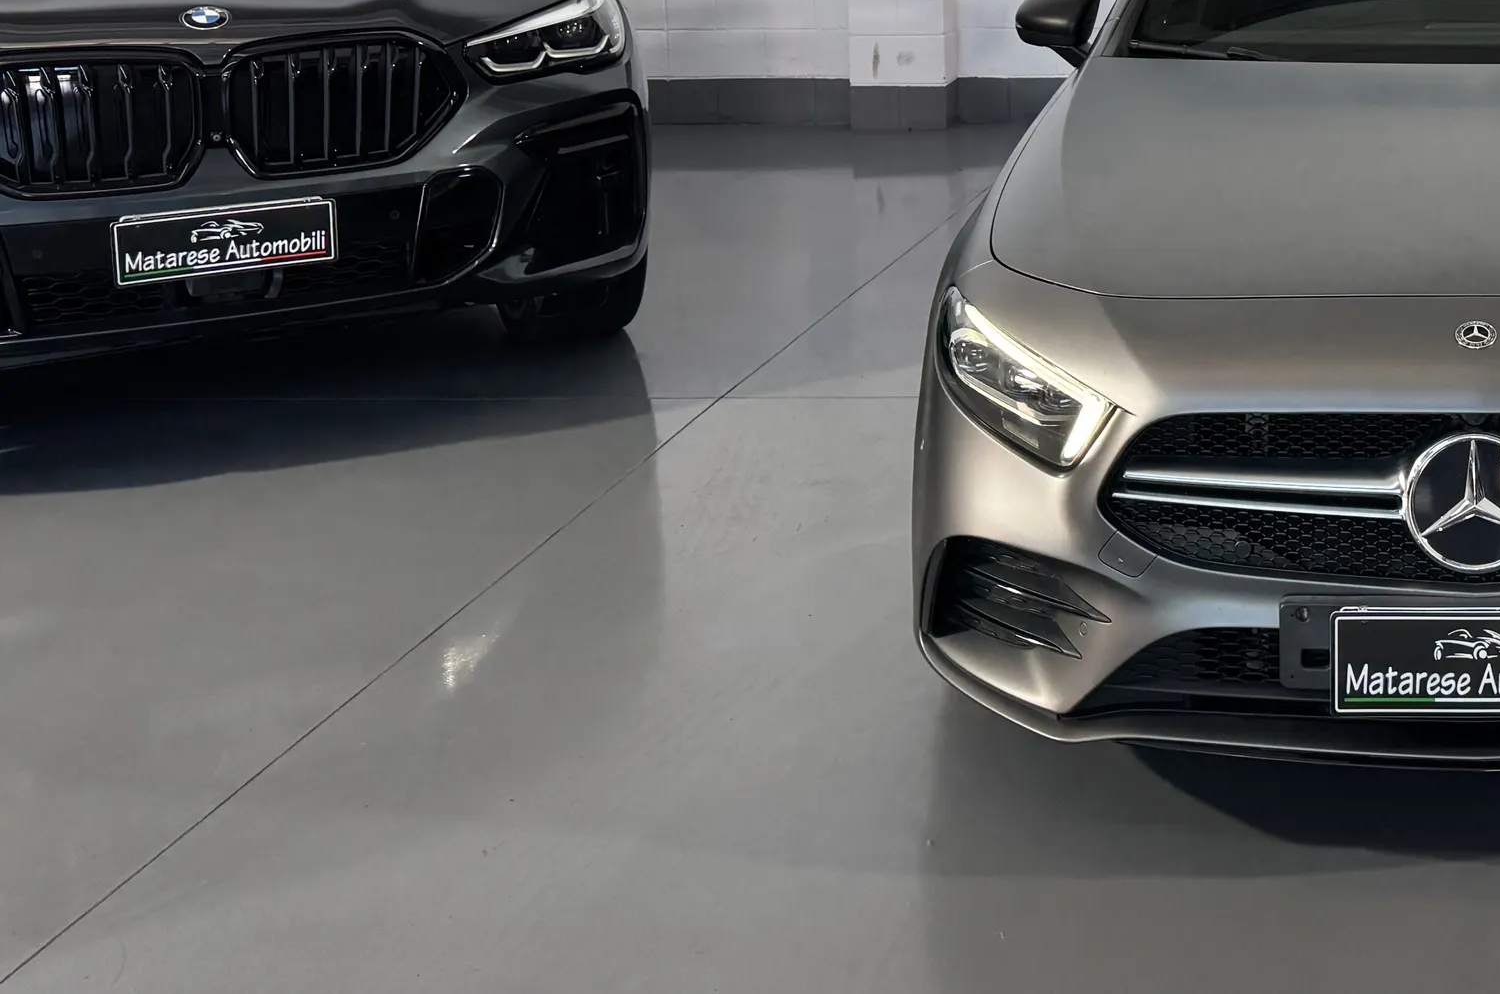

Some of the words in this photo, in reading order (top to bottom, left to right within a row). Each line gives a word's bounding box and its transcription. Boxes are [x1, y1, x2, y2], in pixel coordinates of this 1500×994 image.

[125, 246, 221, 274] Matarese
[225, 230, 327, 261] Automobili
[1345, 662, 1472, 696] Matarese
